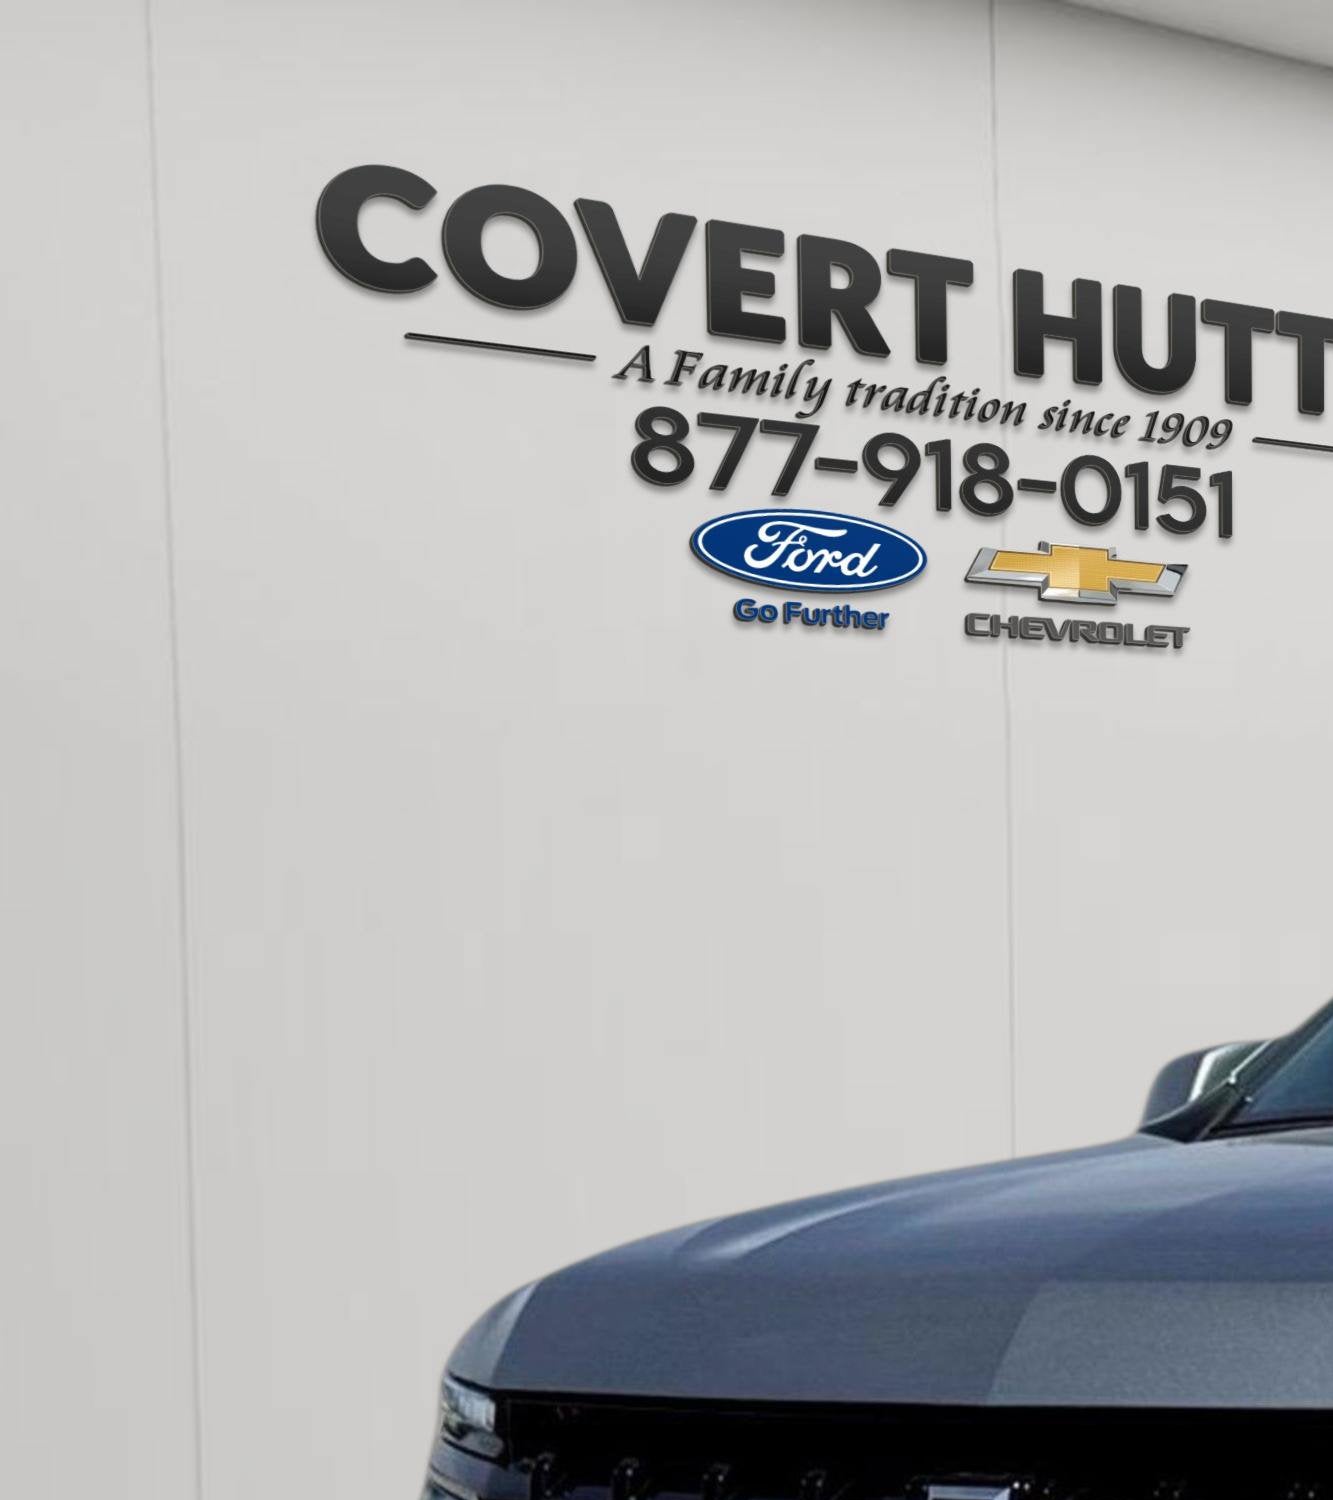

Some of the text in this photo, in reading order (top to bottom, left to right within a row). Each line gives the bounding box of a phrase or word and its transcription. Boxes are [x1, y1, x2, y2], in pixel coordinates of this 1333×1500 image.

[316, 164, 974, 367] COVERT
[613, 345, 1233, 449] A Family tradition since 1909
[630, 406, 1232, 538] 877-918-0151
[743, 521, 882, 579] Ford
[734, 598, 889, 630] Go Further
[965, 613, 1190, 649] CHEVROLET
